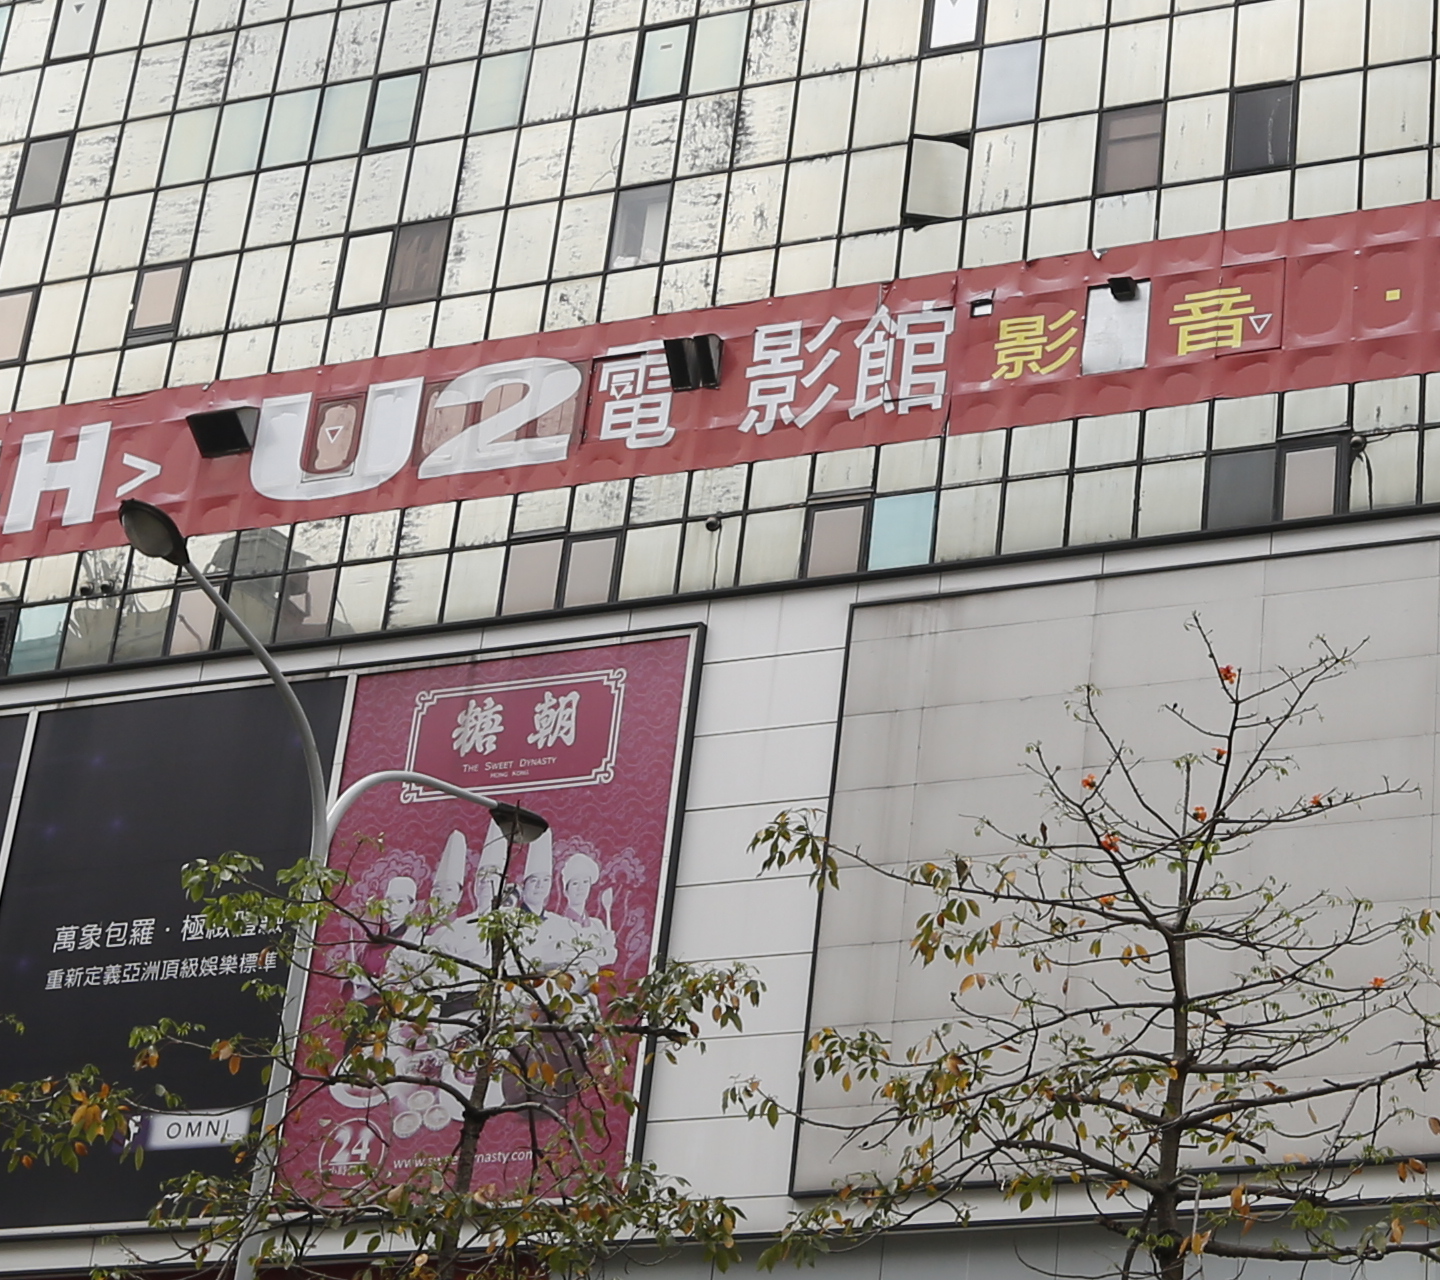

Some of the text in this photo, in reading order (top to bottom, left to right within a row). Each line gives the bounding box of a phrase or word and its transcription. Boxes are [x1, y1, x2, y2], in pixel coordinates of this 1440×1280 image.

[249, 356, 583, 501] U2
[451, 690, 580, 758] 糖朝
[463, 756, 558, 773] THE SWEET DYNASTY
[45, 951, 278, 990] 重新定義亞洲頂級娛樂標準
[164, 1118, 231, 1143] OMNI
[330, 1126, 371, 1163] 24
